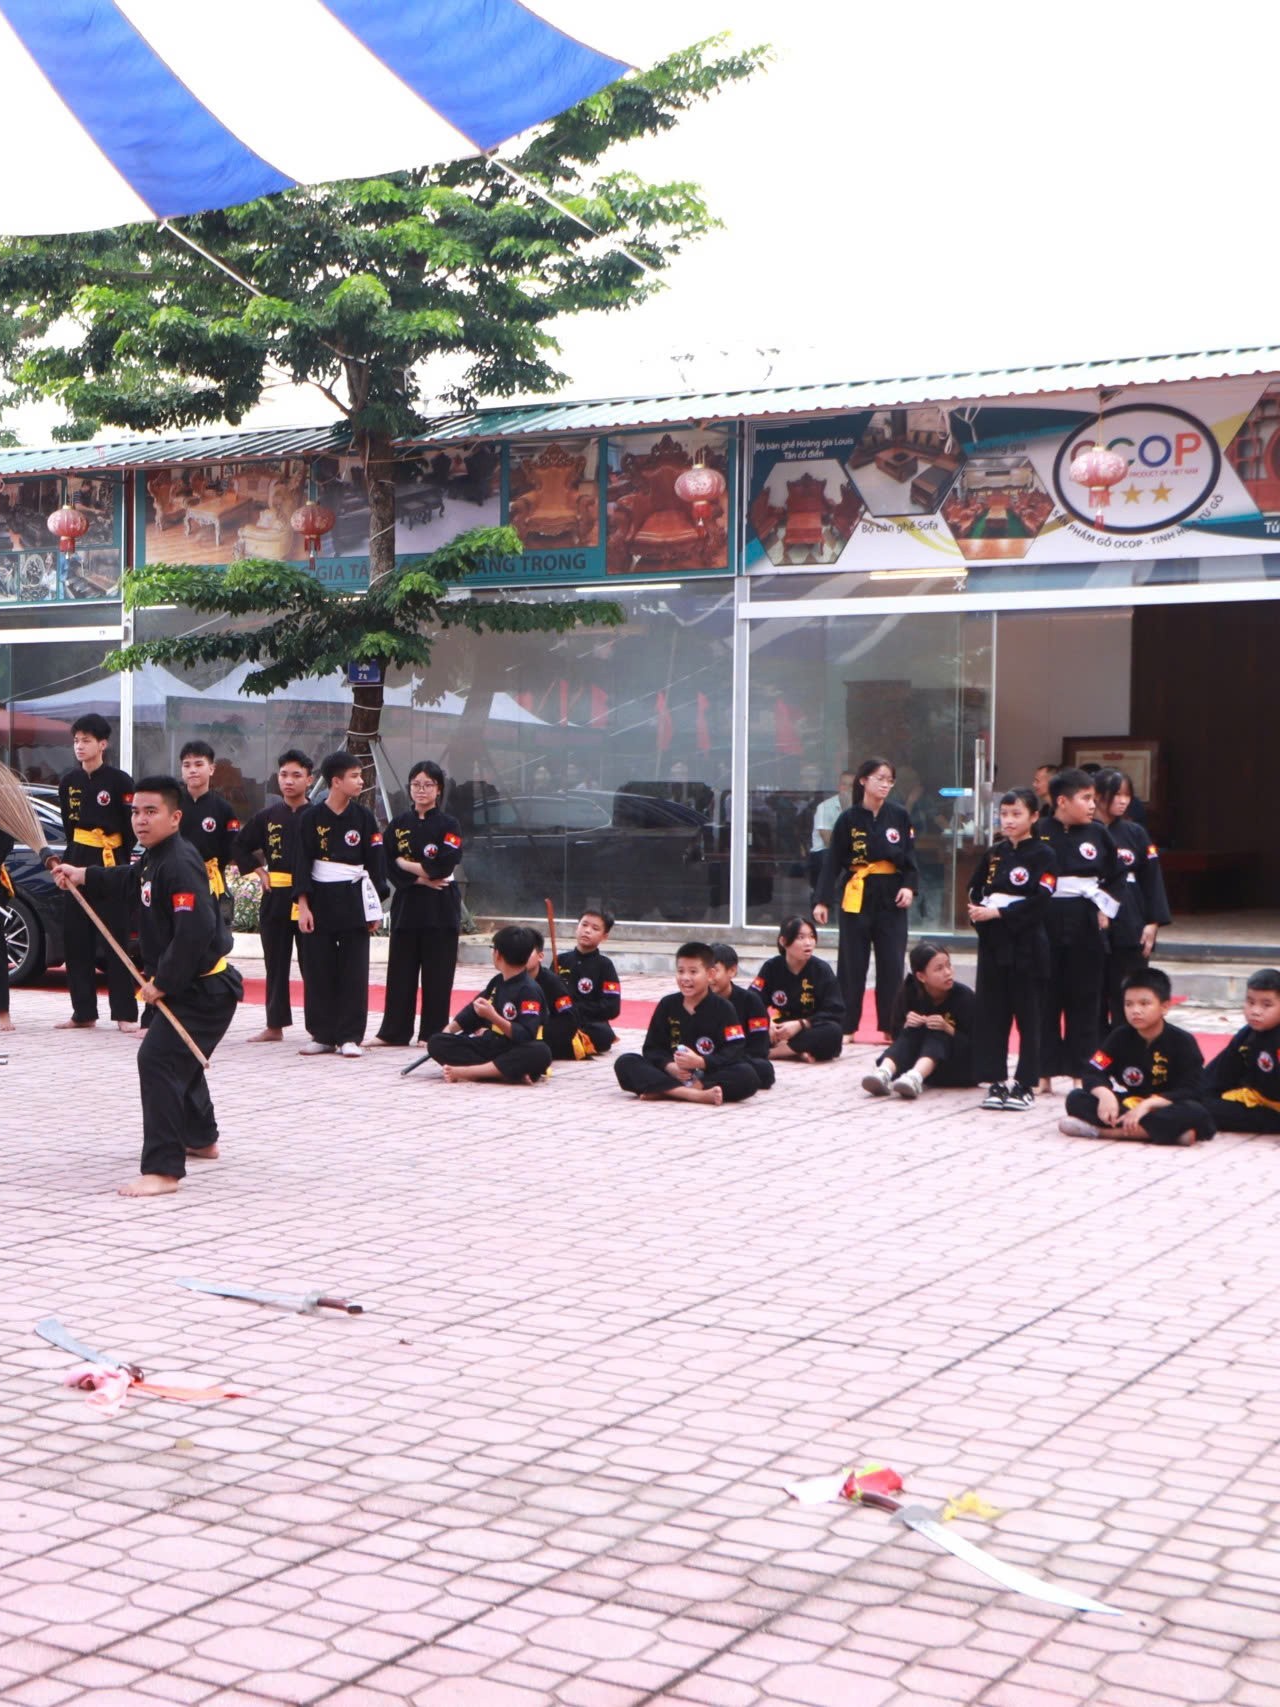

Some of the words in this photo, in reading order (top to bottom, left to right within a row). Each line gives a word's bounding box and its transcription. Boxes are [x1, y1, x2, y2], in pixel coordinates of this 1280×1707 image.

[918, 520, 938, 531] Sofa
[1113, 539, 1143, 549] OCOP
[317, 563, 345, 581] GIA
